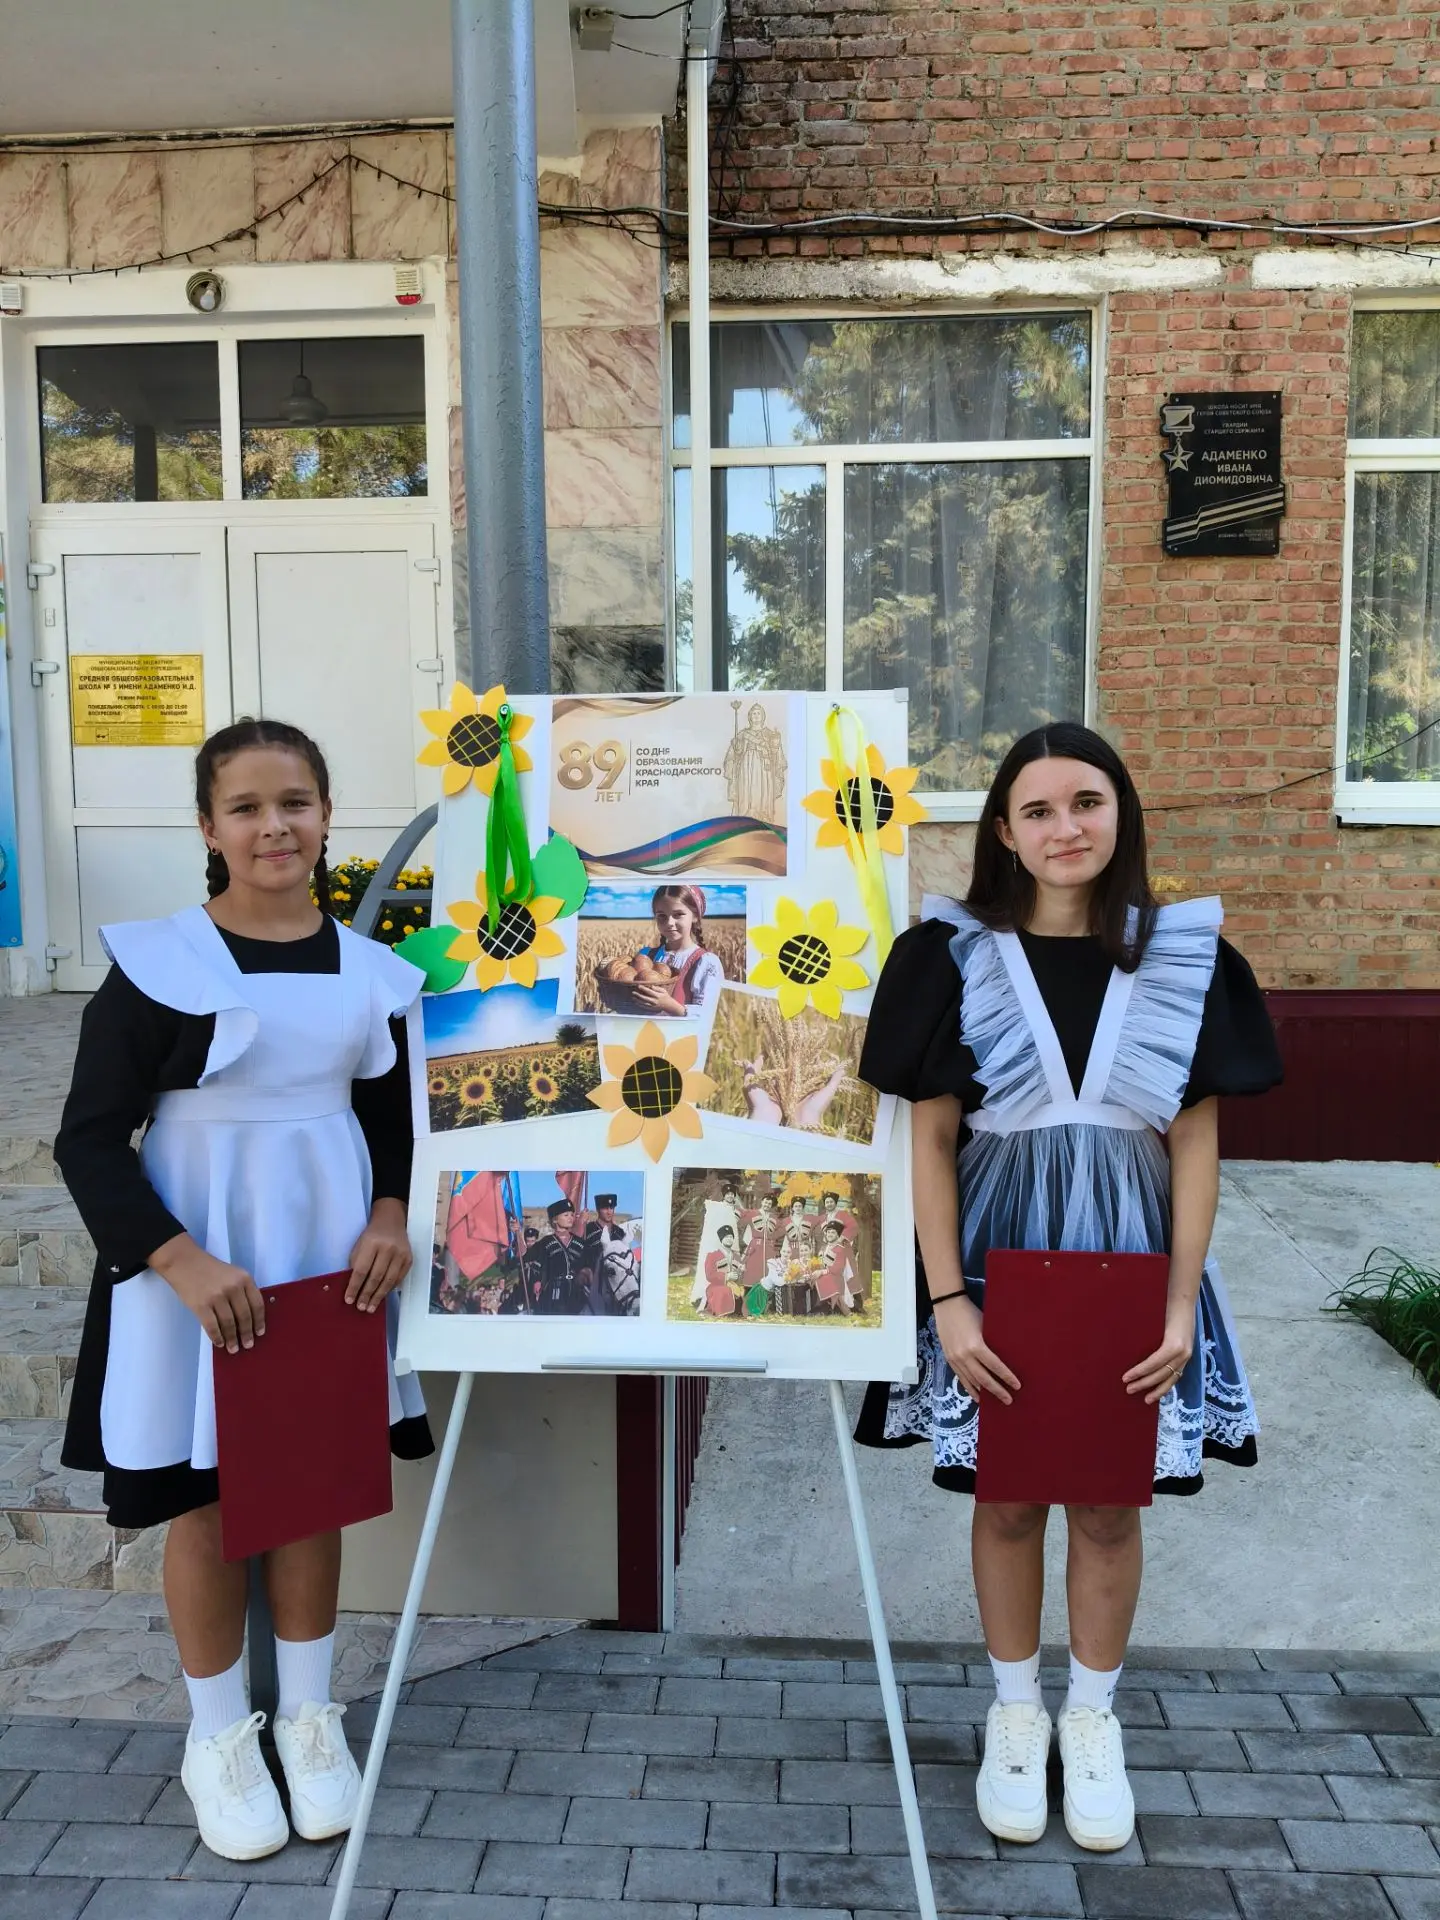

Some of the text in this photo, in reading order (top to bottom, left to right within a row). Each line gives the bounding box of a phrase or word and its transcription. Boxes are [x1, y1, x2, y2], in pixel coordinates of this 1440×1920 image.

[1201, 449, 1267, 462] АДАМЕНКО
[1217, 463, 1252, 473] ИВАНА
[1193, 474, 1273, 486] ДИОМИДОВИЧА
[636, 747, 670, 756] СО ДНЯ
[557, 739, 627, 790] 89
[635, 757, 703, 766] ОБРАЗОВАНИЯ
[635, 767, 722, 777] КРАСНОДАРСКОГО
[635, 779, 660, 787] КРАЯ
[594, 791, 624, 802] ЛЕТ
